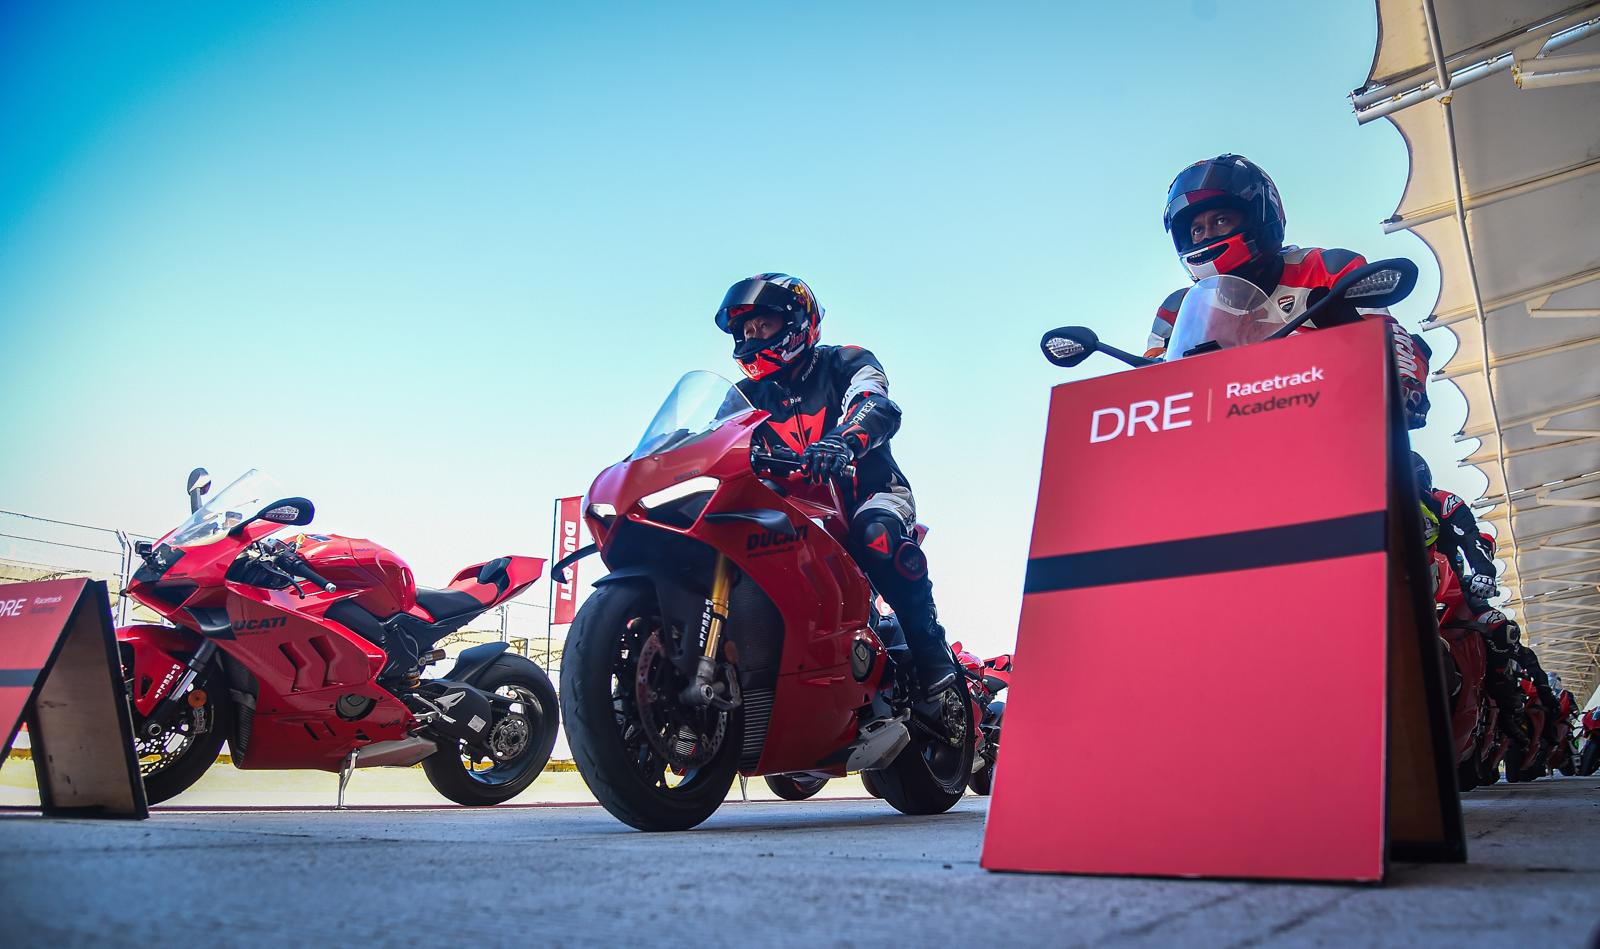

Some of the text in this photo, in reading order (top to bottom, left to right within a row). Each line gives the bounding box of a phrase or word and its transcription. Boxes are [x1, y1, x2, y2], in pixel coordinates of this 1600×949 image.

[1226, 366, 1324, 398] Racetrack
[1089, 391, 1194, 444] DRE
[1226, 391, 1321, 419] Academy
[232, 616, 287, 630] UCATI
